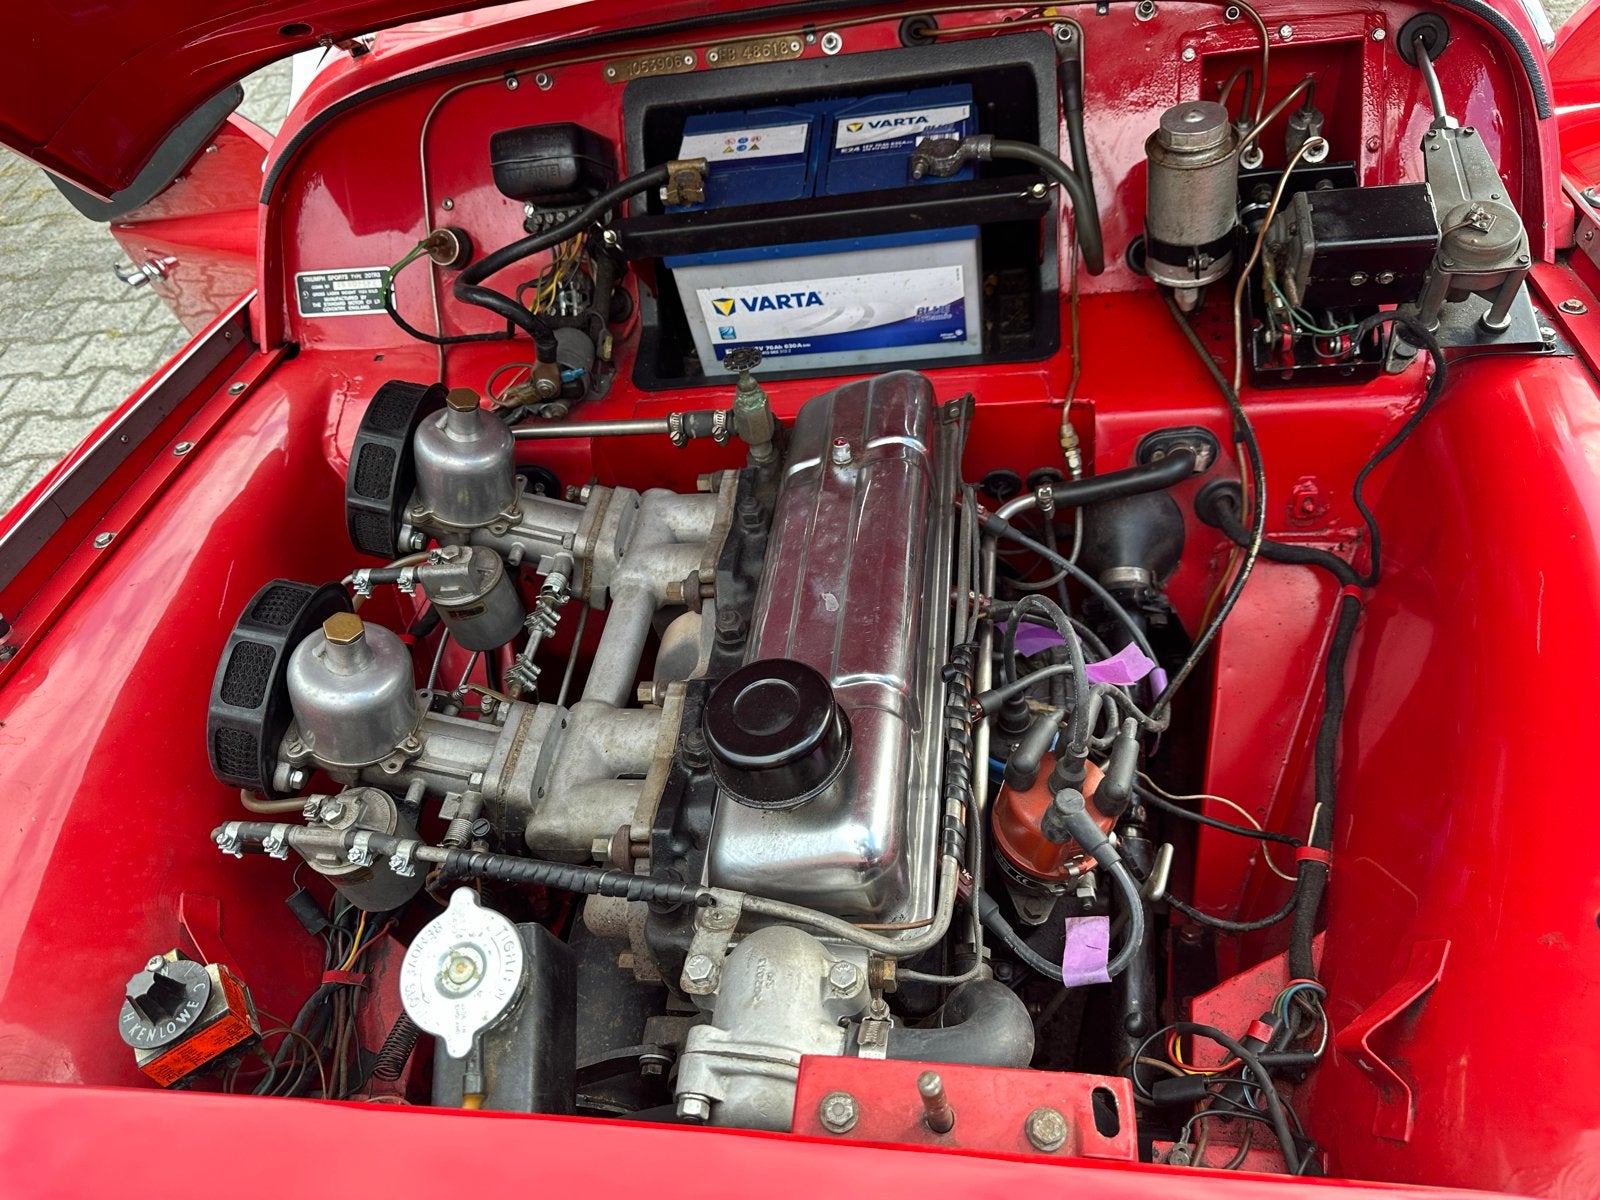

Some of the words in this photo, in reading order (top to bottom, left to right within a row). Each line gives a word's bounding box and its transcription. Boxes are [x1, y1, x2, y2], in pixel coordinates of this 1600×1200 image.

[742, 41, 789, 60] 48618
[868, 116, 929, 129] VARTA
[327, 273, 349, 281] SPORTS
[740, 291, 824, 312] VARTA
[193, 982, 206, 992] C
[122, 1011, 135, 1023] H
[128, 1000, 200, 1042] KENLOWE
